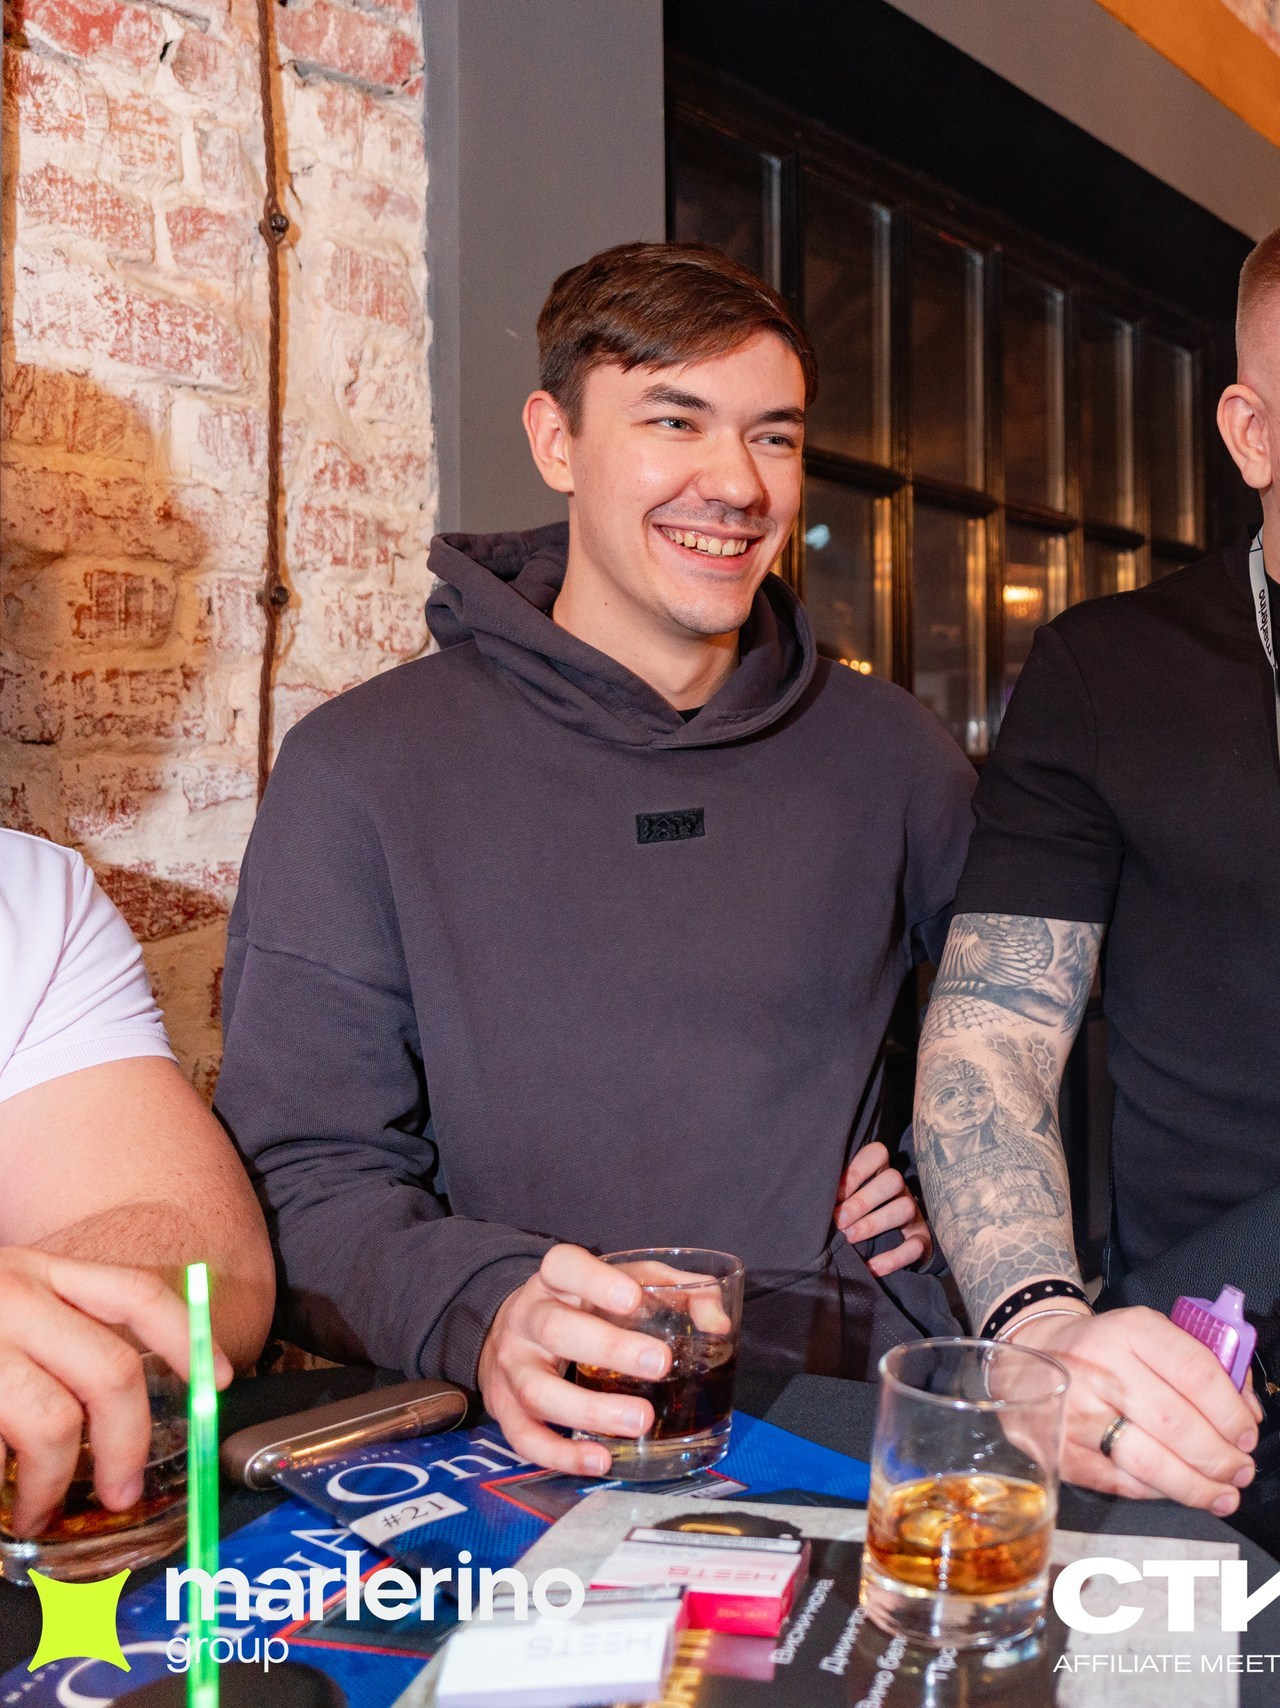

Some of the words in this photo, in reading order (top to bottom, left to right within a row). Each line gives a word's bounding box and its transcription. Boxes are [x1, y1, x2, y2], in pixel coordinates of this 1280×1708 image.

[381, 1500, 446, 1529] #21
[666, 1564, 778, 1581] HEETS
[526, 1629, 652, 1660] HEETS
[817, 1604, 867, 1676] Джин-то
[876, 1634, 908, 1671] бел
[936, 1645, 958, 1680] Про
